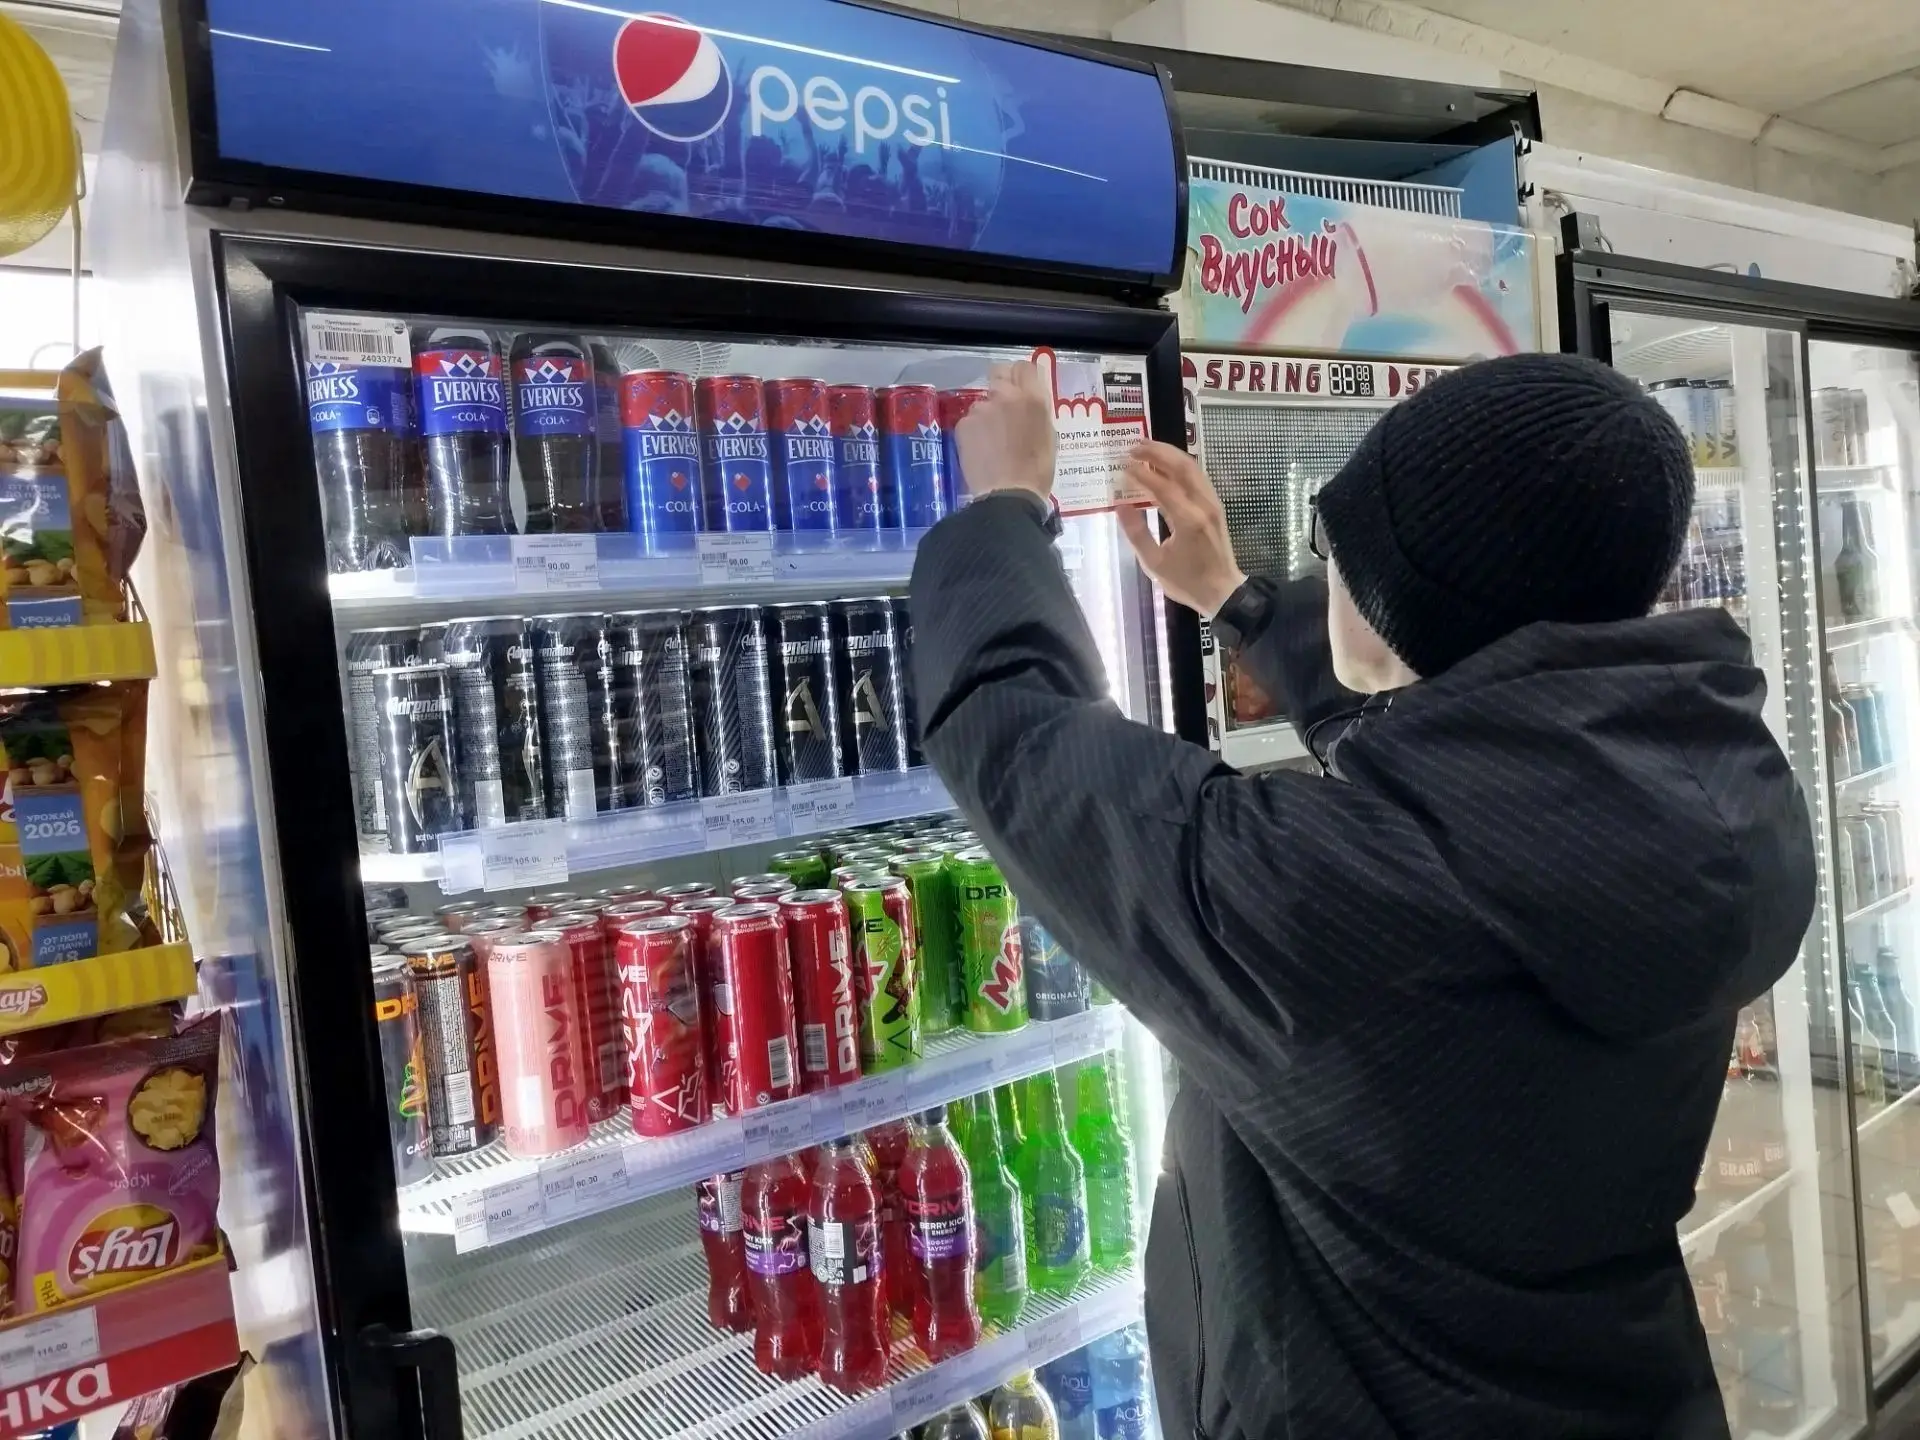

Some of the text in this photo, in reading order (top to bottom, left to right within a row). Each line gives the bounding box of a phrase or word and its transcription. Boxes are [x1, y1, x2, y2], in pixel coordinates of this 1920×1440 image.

[750, 63, 951, 152] pepsi
[1228, 192, 1291, 238] Сок
[1199, 217, 1338, 315] Вкусный
[361, 353, 403, 365] 24033774
[1204, 359, 1322, 393] SPRING
[433, 379, 502, 405] EVERVESS
[520, 387, 586, 409] EVERVESS
[315, 408, 337, 423] COLA
[457, 411, 486, 423] COLA
[538, 415, 566, 426] COLA
[1100, 427, 1141, 440] передача
[708, 435, 768, 459] EVERVESS
[1058, 465, 1106, 477] ЗАПРЕЩЕНА
[729, 501, 761, 513] COLA
[20, 612, 71, 625] УРОЖАЙ
[26, 809, 75, 823] УРОЖАЙ
[23, 819, 82, 841] 2026
[39, 938, 92, 957] ДО ПАЧКИ
[42, 931, 89, 946] ОТ ПОЛЯ
[827, 926, 858, 1075] DRIVE
[1035, 989, 1079, 1002] ORIGINAL
[467, 972, 499, 1125] DRIVE
[542, 972, 580, 1130] DRIVE
[919, 1214, 968, 1232] BERRY KICK
[931, 1226, 957, 1237] ENERGY
[1023, 1193, 1038, 1265] DRIVE
[73, 1220, 174, 1281] Lay's
